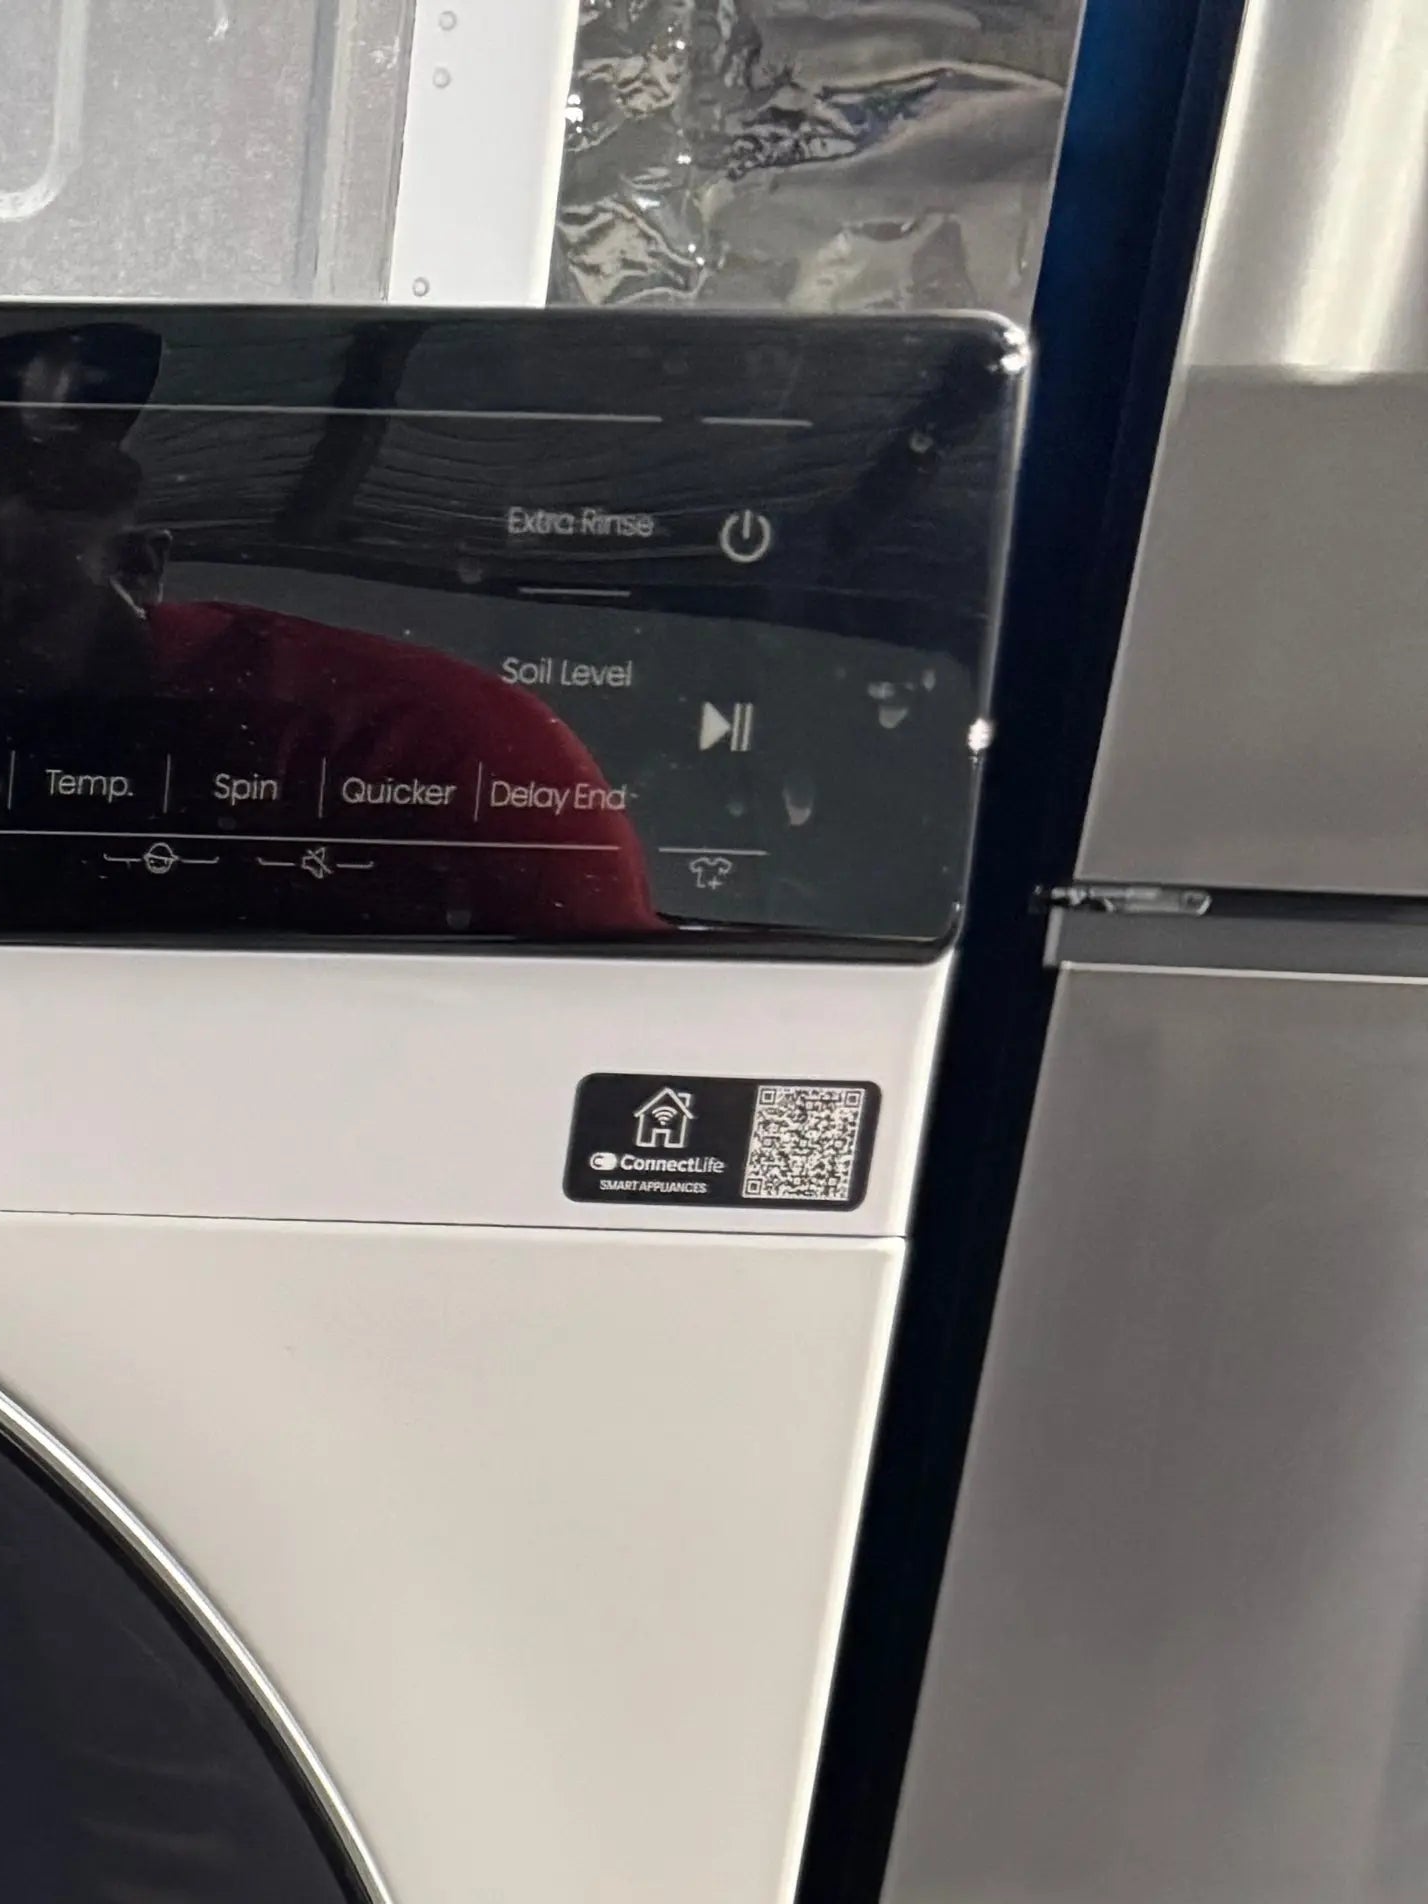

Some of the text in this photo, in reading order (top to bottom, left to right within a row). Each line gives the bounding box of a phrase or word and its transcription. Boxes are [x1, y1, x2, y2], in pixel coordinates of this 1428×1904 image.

[508, 507, 654, 537] Extra Rinse
[501, 656, 632, 687] Soil Level
[46, 769, 133, 803] Temp.
[214, 773, 277, 806] Spin
[342, 777, 457, 806] Quicker
[491, 780, 625, 815] Delay End
[620, 1153, 725, 1173] ConnectLife
